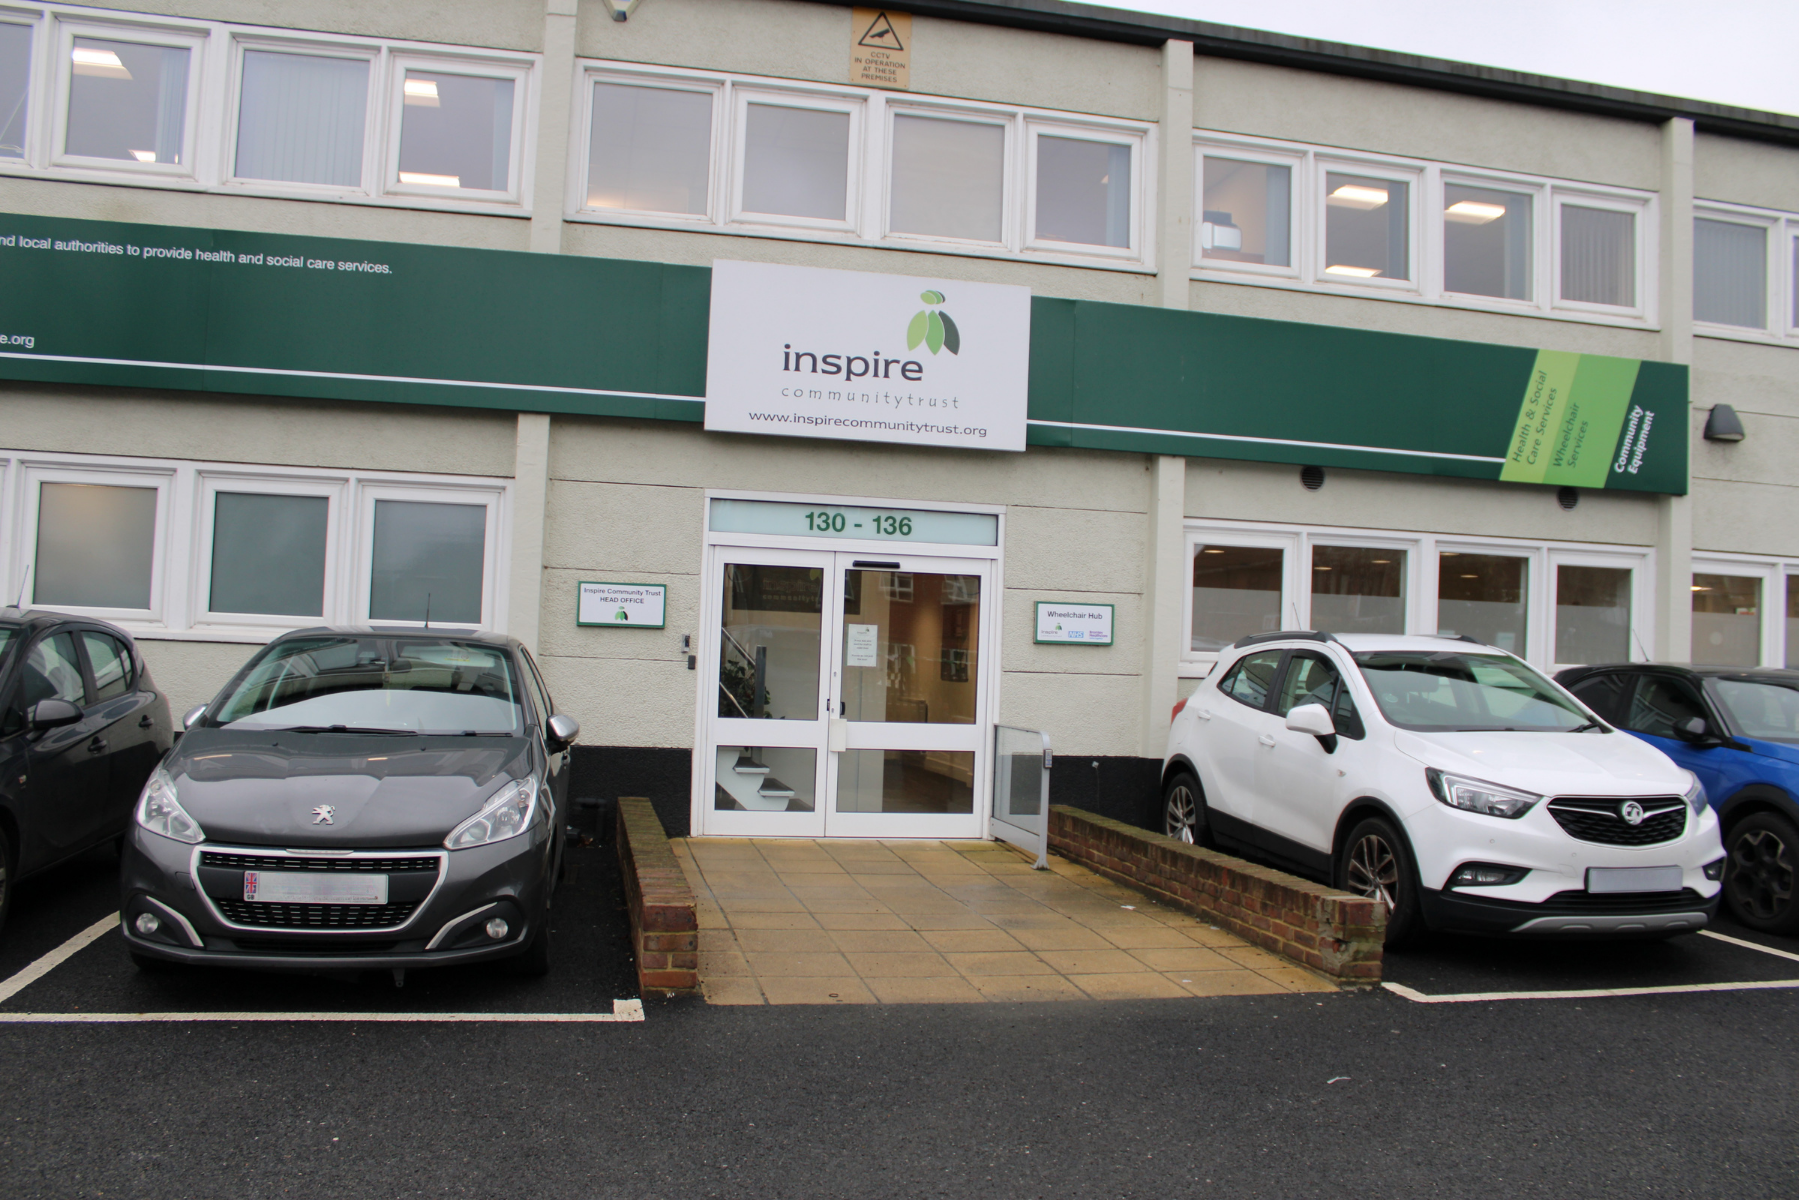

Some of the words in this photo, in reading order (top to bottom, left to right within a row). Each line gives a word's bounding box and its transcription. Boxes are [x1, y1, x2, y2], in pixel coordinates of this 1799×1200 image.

[864, 58, 906, 69] OPERATION
[870, 51, 890, 59] CCTV
[861, 72, 897, 83] PREMISES
[874, 67, 897, 75] THESE
[19, 236, 52, 249] local
[54, 240, 124, 255] authorities
[126, 244, 140, 256] to
[143, 247, 193, 260] provide
[195, 248, 236, 263] health
[238, 253, 263, 265] and
[266, 255, 304, 268] social
[306, 259, 335, 270] care
[337, 260, 393, 274] services.
[782, 343, 924, 382] inspire
[781, 386, 960, 409] communitytrust
[1530, 370, 1548, 406] Social
[748, 411, 988, 438] www.inspirecommunitytrust.org
[1525, 409, 1536, 421] &
[1526, 438, 1542, 465] Care
[1536, 387, 1557, 436] Services
[1512, 422, 1532, 463] Health
[1552, 402, 1580, 467] Wheelchair
[1567, 420, 1589, 468] Services
[1614, 404, 1645, 473] Community
[1627, 410, 1655, 474] Equipment
[805, 511, 846, 533] 130
[872, 515, 913, 537] 136
[584, 587, 606, 595] Inspire
[607, 588, 643, 597] Community
[1047, 610, 1086, 619] Wheelchair
[1088, 612, 1103, 620] Hub
